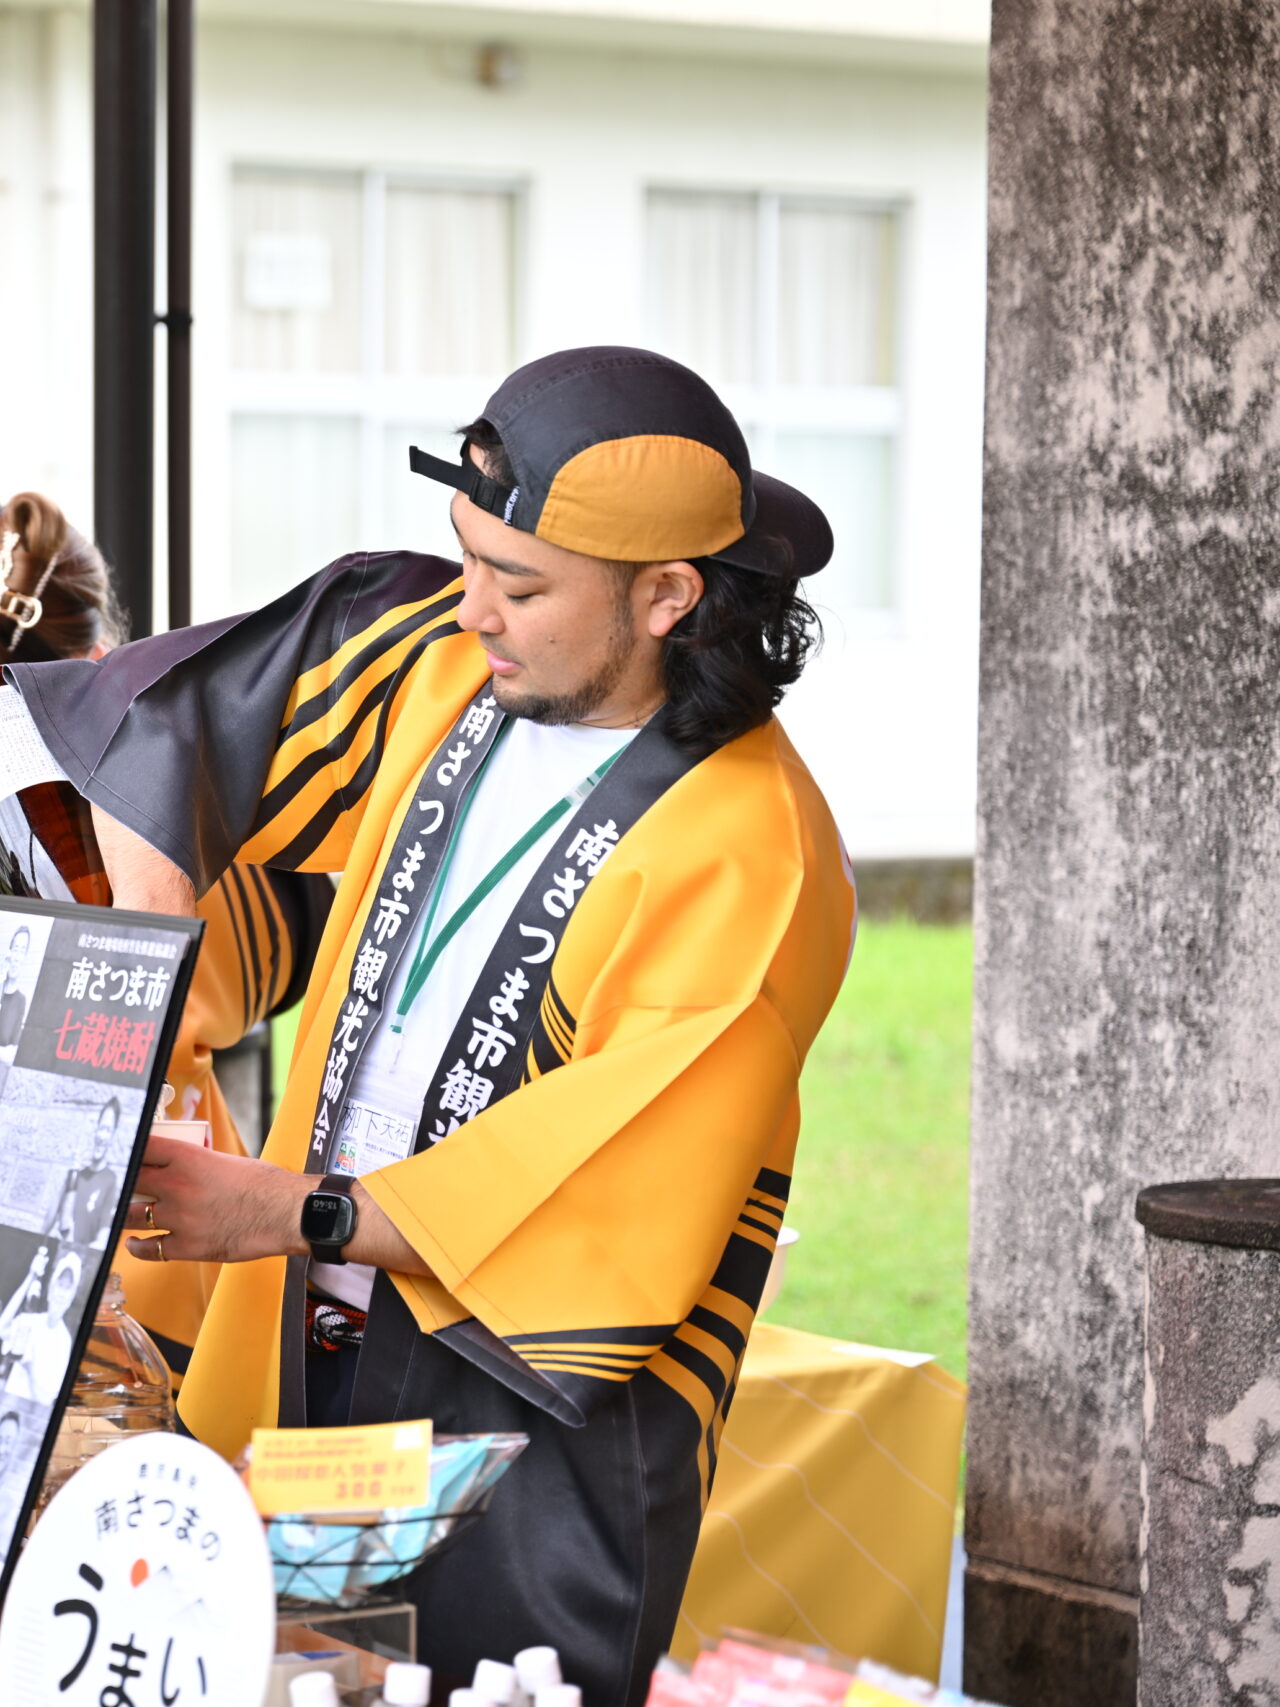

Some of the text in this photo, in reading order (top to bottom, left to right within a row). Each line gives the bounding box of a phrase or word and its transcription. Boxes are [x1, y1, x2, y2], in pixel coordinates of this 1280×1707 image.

[313, 694, 497, 1156] 南さつま市観光協会
[65, 957, 171, 1011] 南さつま市
[53, 1009, 157, 1075] 七蔵焼酎
[95, 1490, 219, 1562] 南さつまの
[54, 1563, 207, 1707] うまい
